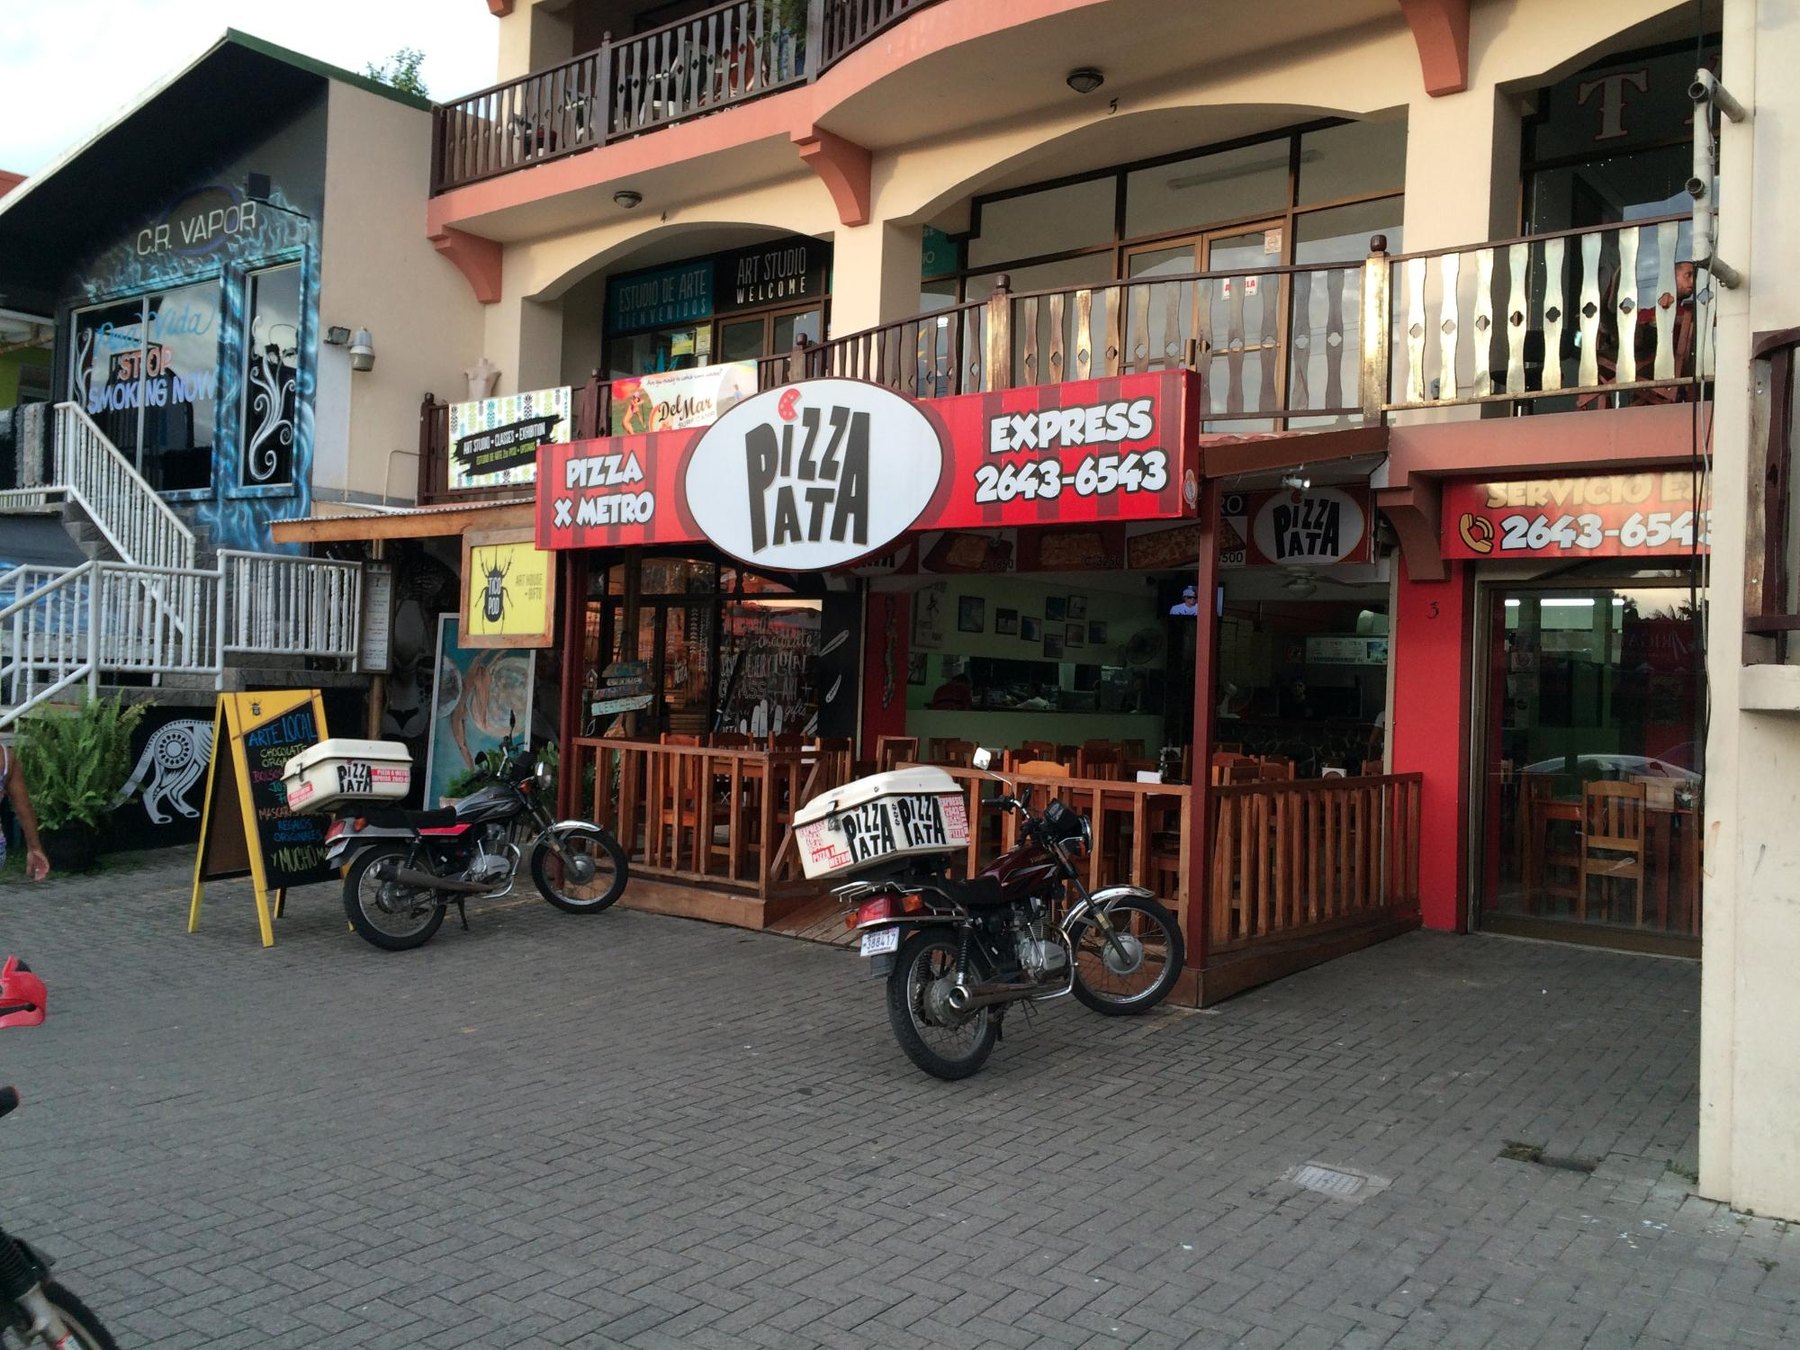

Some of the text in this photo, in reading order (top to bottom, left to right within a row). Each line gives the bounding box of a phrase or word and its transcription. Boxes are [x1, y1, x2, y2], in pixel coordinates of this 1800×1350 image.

[180, 201, 257, 244] VAPOR
[737, 246, 807, 285] ART STUDIO
[619, 269, 707, 312] ESTUDIO DE ARTE
[736, 276, 807, 304] WELCOME
[118, 347, 172, 381] STOP
[87, 371, 217, 414] SMOKING NOW
[658, 394, 713, 422] Del Mar
[463, 422, 546, 455] ART STUDIO CLASSES EXHIBITION
[990, 398, 1152, 453] EXPRESS
[566, 450, 644, 488] PIZZA
[975, 450, 1167, 503] 2643-6543
[1486, 473, 1653, 508] SERVICIO
[553, 491, 655, 528] X METRO
[488, 577, 501, 595] TICO
[488, 597, 500, 615] POD
[1427, 601, 1440, 619] 3
[248, 712, 318, 747] ARTE LOCAL
[278, 845, 318, 872] MUCHO
